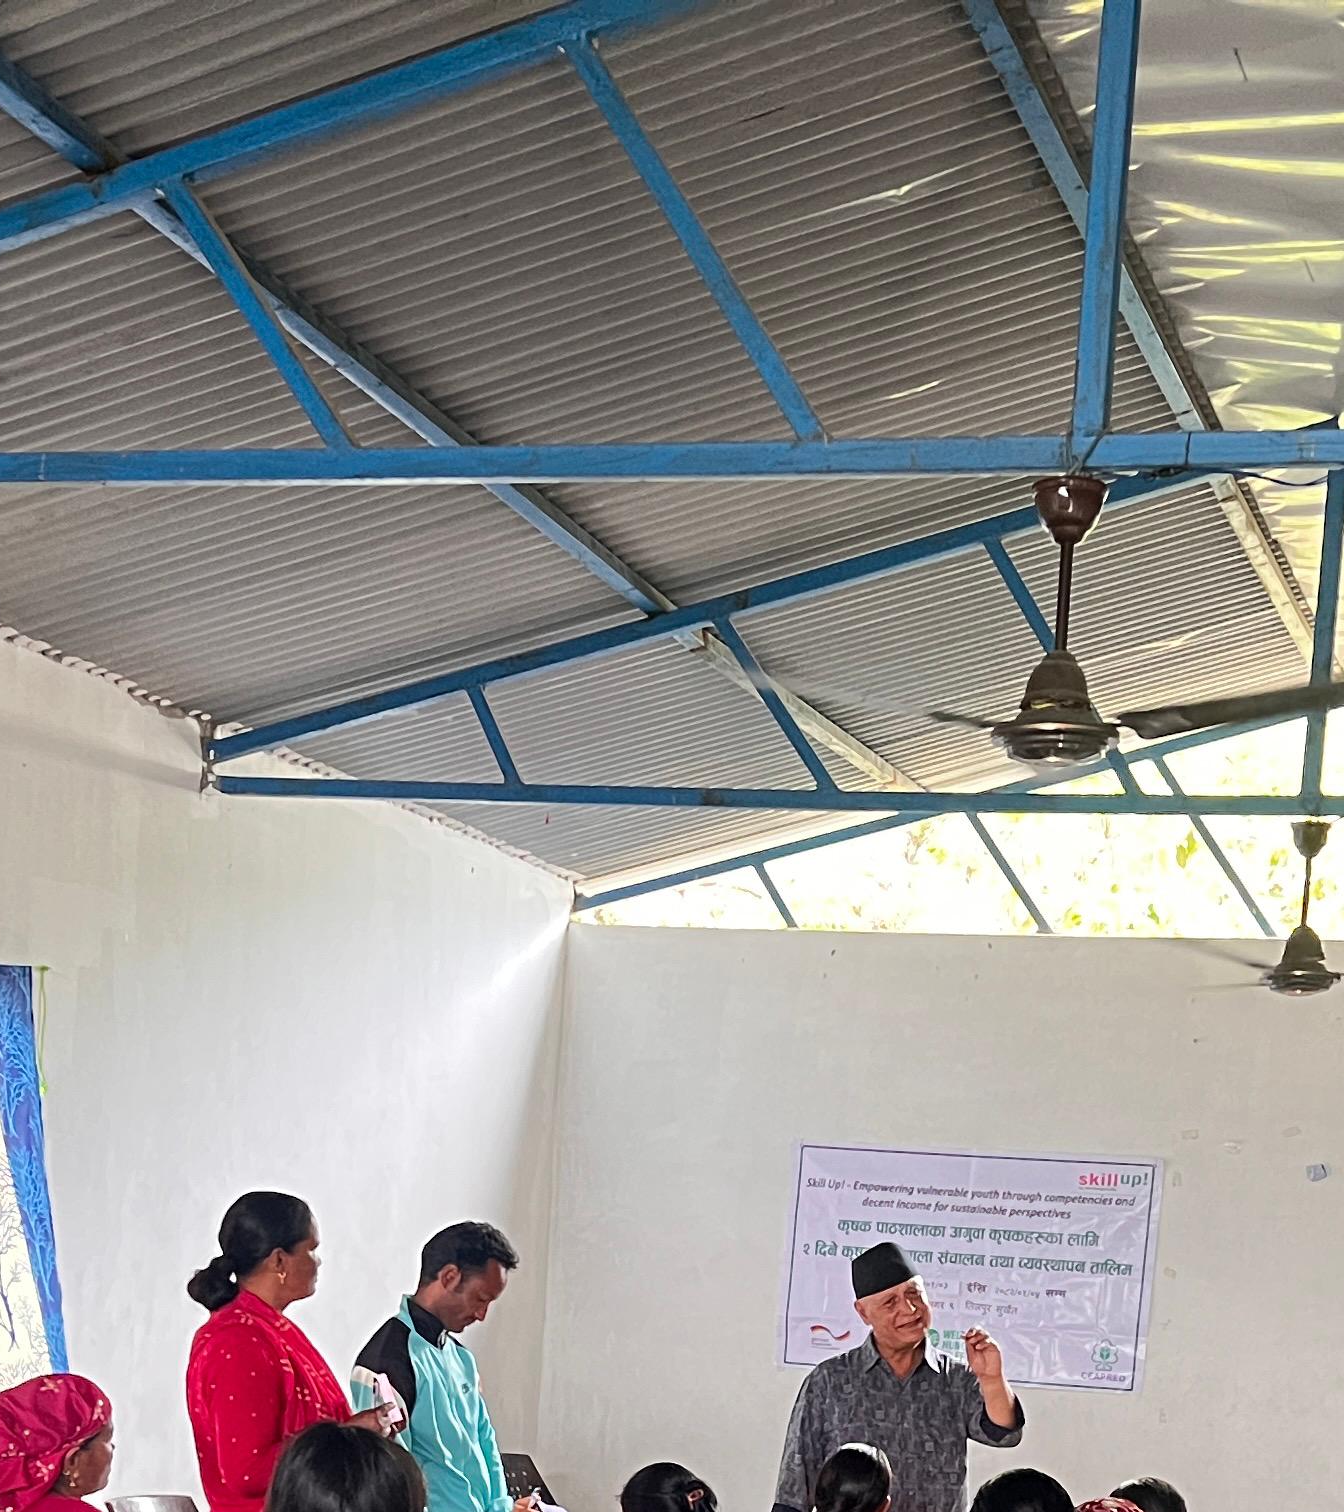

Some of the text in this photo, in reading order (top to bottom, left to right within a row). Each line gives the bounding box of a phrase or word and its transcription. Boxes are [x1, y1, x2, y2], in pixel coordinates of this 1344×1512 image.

[806, 1178, 826, 1188] Skill
[828, 1179, 846, 1191] Up!
[853, 1181, 914, 1195] Empowering
[917, 1185, 969, 1198] vulnerable
[971, 1187, 999, 1200] youth
[1002, 1190, 1041, 1203] through
[1044, 1194, 1112, 1206] competencies
[1115, 1196, 1136, 1207] and
[862, 1197, 1071, 1219] decent income for sustainable perspectives
[838, 1219, 872, 1235] कृषक
[876, 1221, 945, 1237] पाठशालाका
[950, 1226, 985, 1243] अगुवा
[1067, 1231, 1100, 1247] लागि
[803, 1243, 811, 1256] २
[937, 1251, 985, 1267] संचालन
[989, 1255, 1015, 1269] तथा
[1018, 1257, 1085, 1273] व्यवस्थापन
[1090, 1258, 1133, 1276] तालिम
